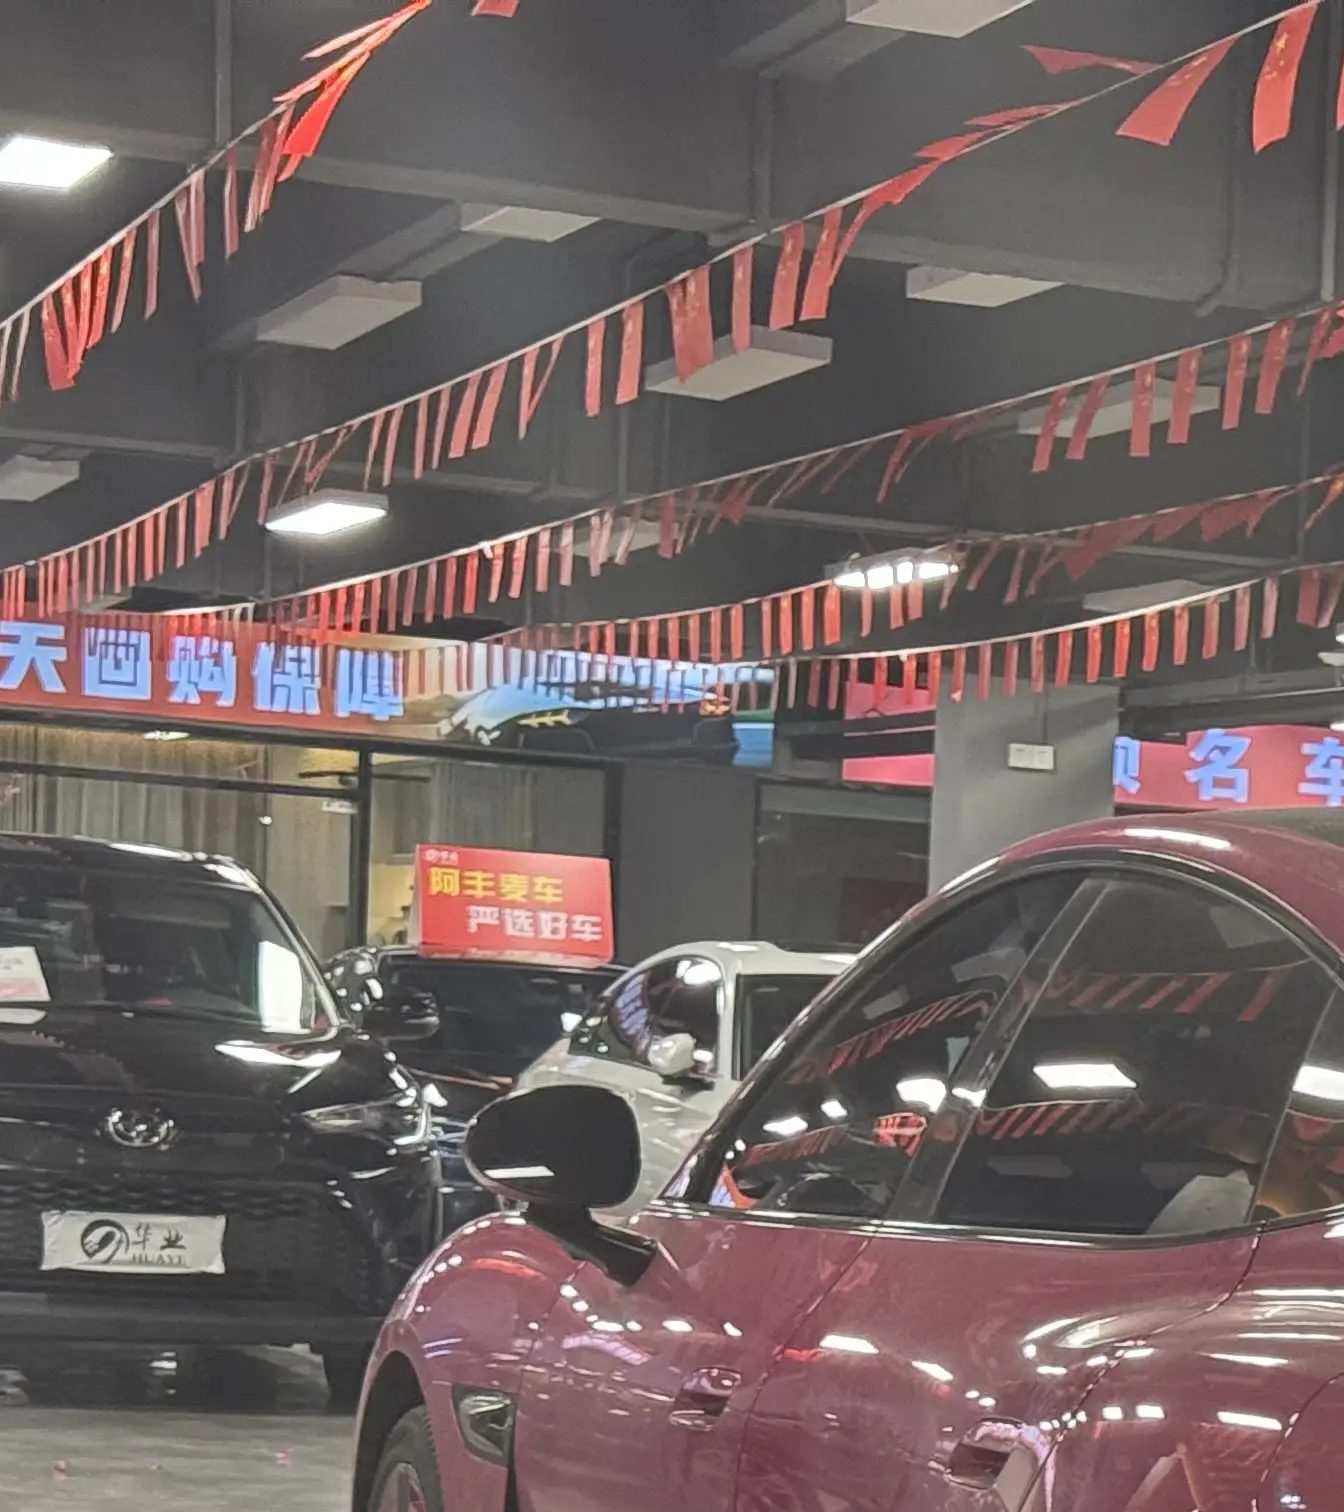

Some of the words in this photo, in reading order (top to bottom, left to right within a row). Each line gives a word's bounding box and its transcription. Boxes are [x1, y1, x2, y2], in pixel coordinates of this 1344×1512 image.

[467, 904, 602, 941] 严选好车
[132, 1222, 186, 1251] 华业
